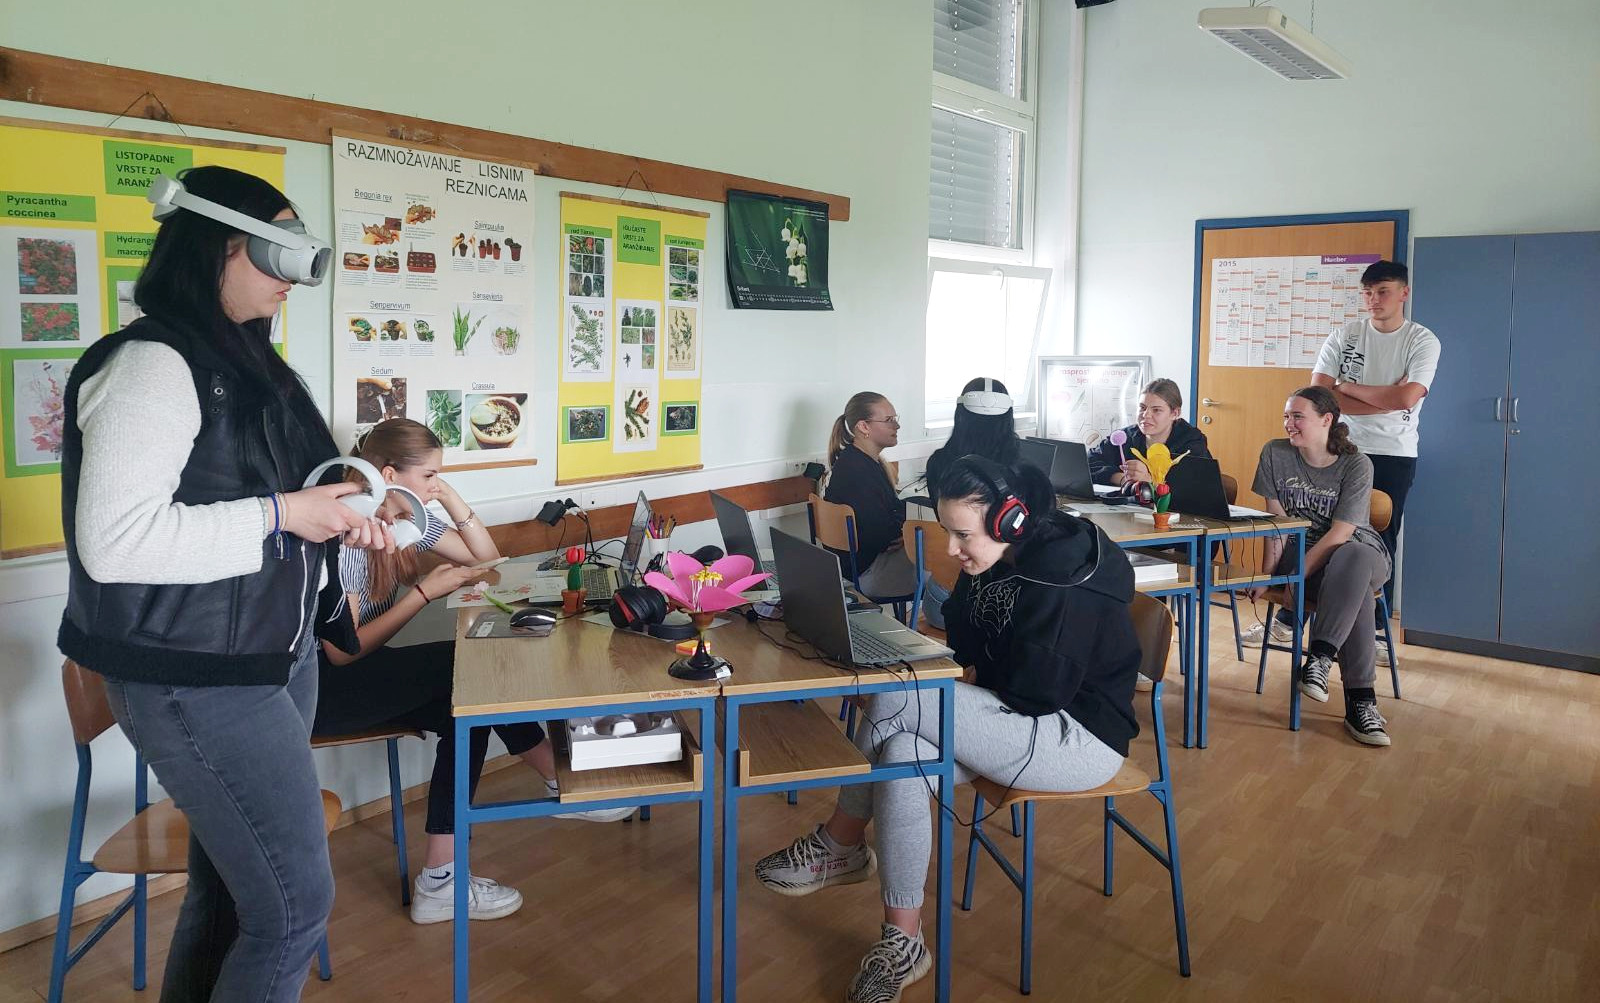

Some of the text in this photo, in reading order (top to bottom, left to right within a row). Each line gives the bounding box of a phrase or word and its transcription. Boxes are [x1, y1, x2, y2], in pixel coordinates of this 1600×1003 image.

[115, 150, 175, 164] LISTOPADNE
[347, 142, 524, 183] RAZMNOŽAVANJE LISNIM
[116, 164, 161, 176] VRSTE ZA
[117, 177, 154, 188] ARANŽ
[354, 188, 382, 200] Begonia
[383, 194, 393, 203] rex
[446, 178, 528, 202] REZNICAMA
[7, 195, 68, 206] Pyracantha
[8, 209, 56, 218] coccinea
[116, 235, 154, 246] Hydrang
[117, 249, 152, 257] macrop
[370, 366, 394, 375] Sedum
